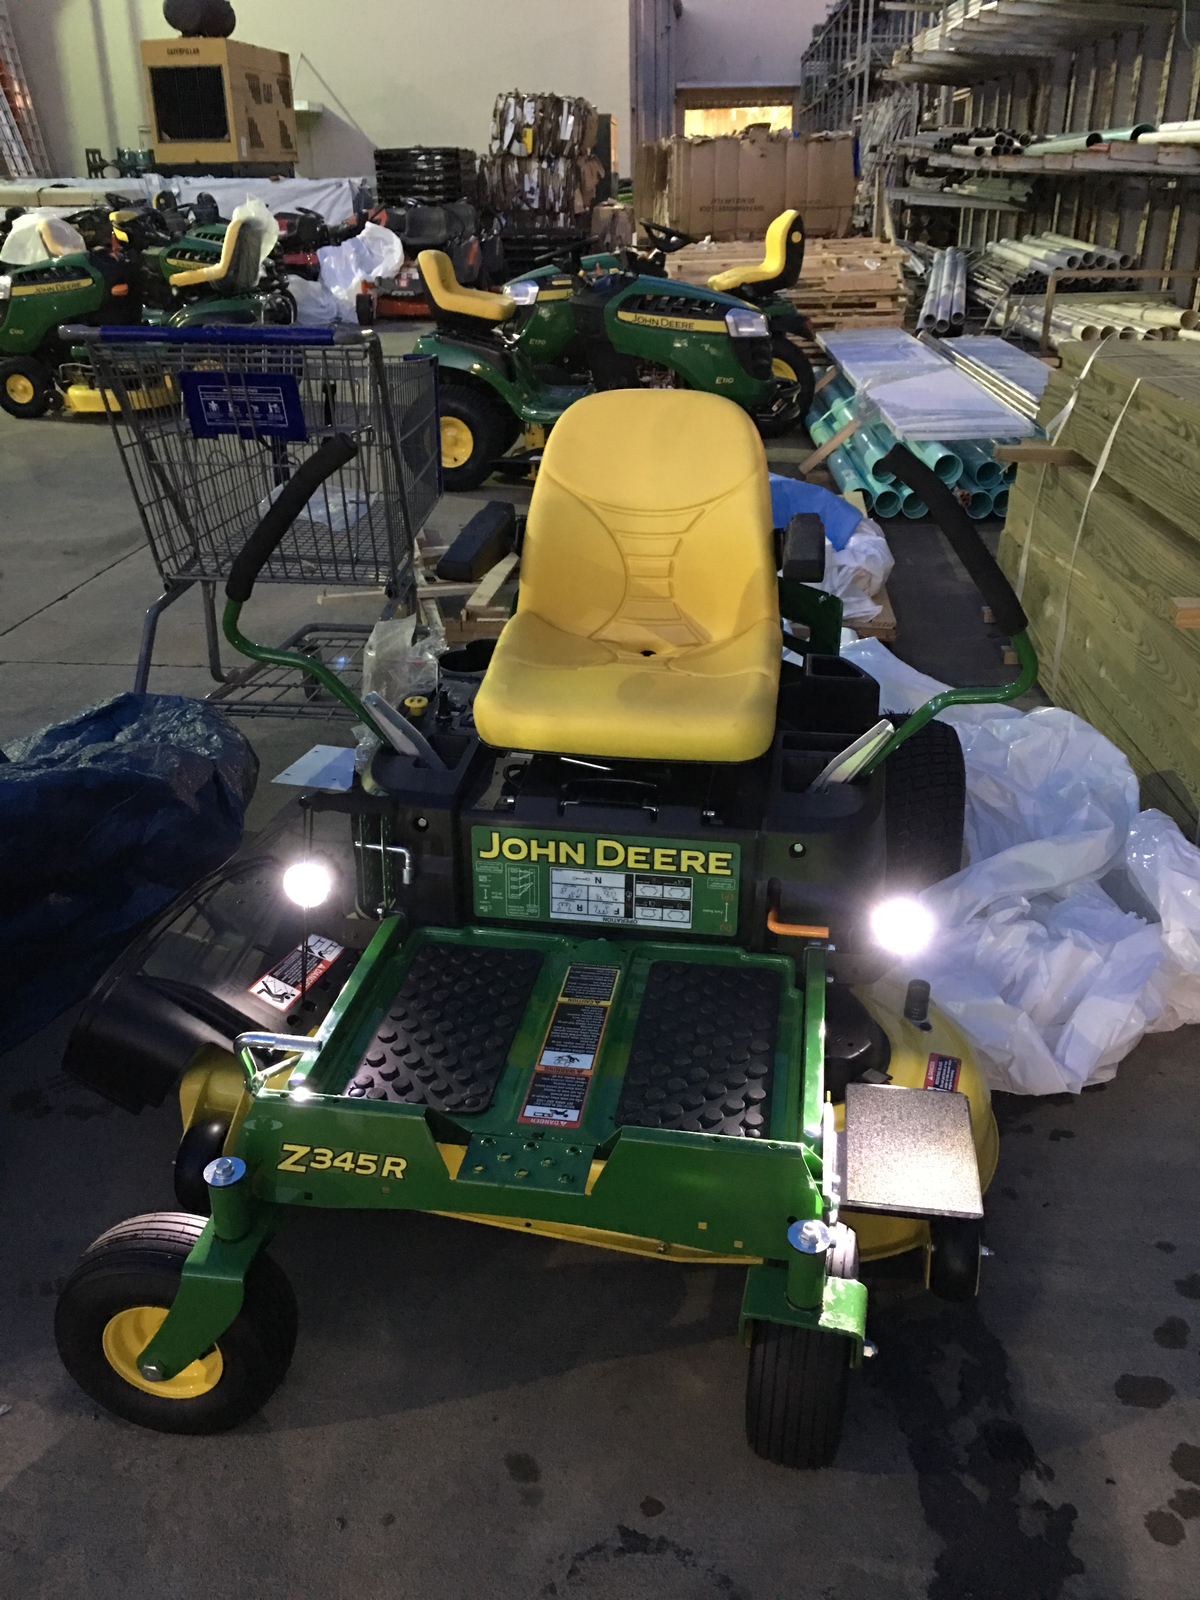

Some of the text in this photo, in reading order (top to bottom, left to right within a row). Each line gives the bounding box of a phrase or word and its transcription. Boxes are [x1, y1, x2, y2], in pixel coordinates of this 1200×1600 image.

[167, 47, 200, 56] CATERPILLAR
[36, 282, 82, 294] JOHN DEERE
[632, 314, 695, 330] JOHN DEERE
[478, 832, 734, 876] JOHN DEERE
[277, 1143, 408, 1179] Z345R
